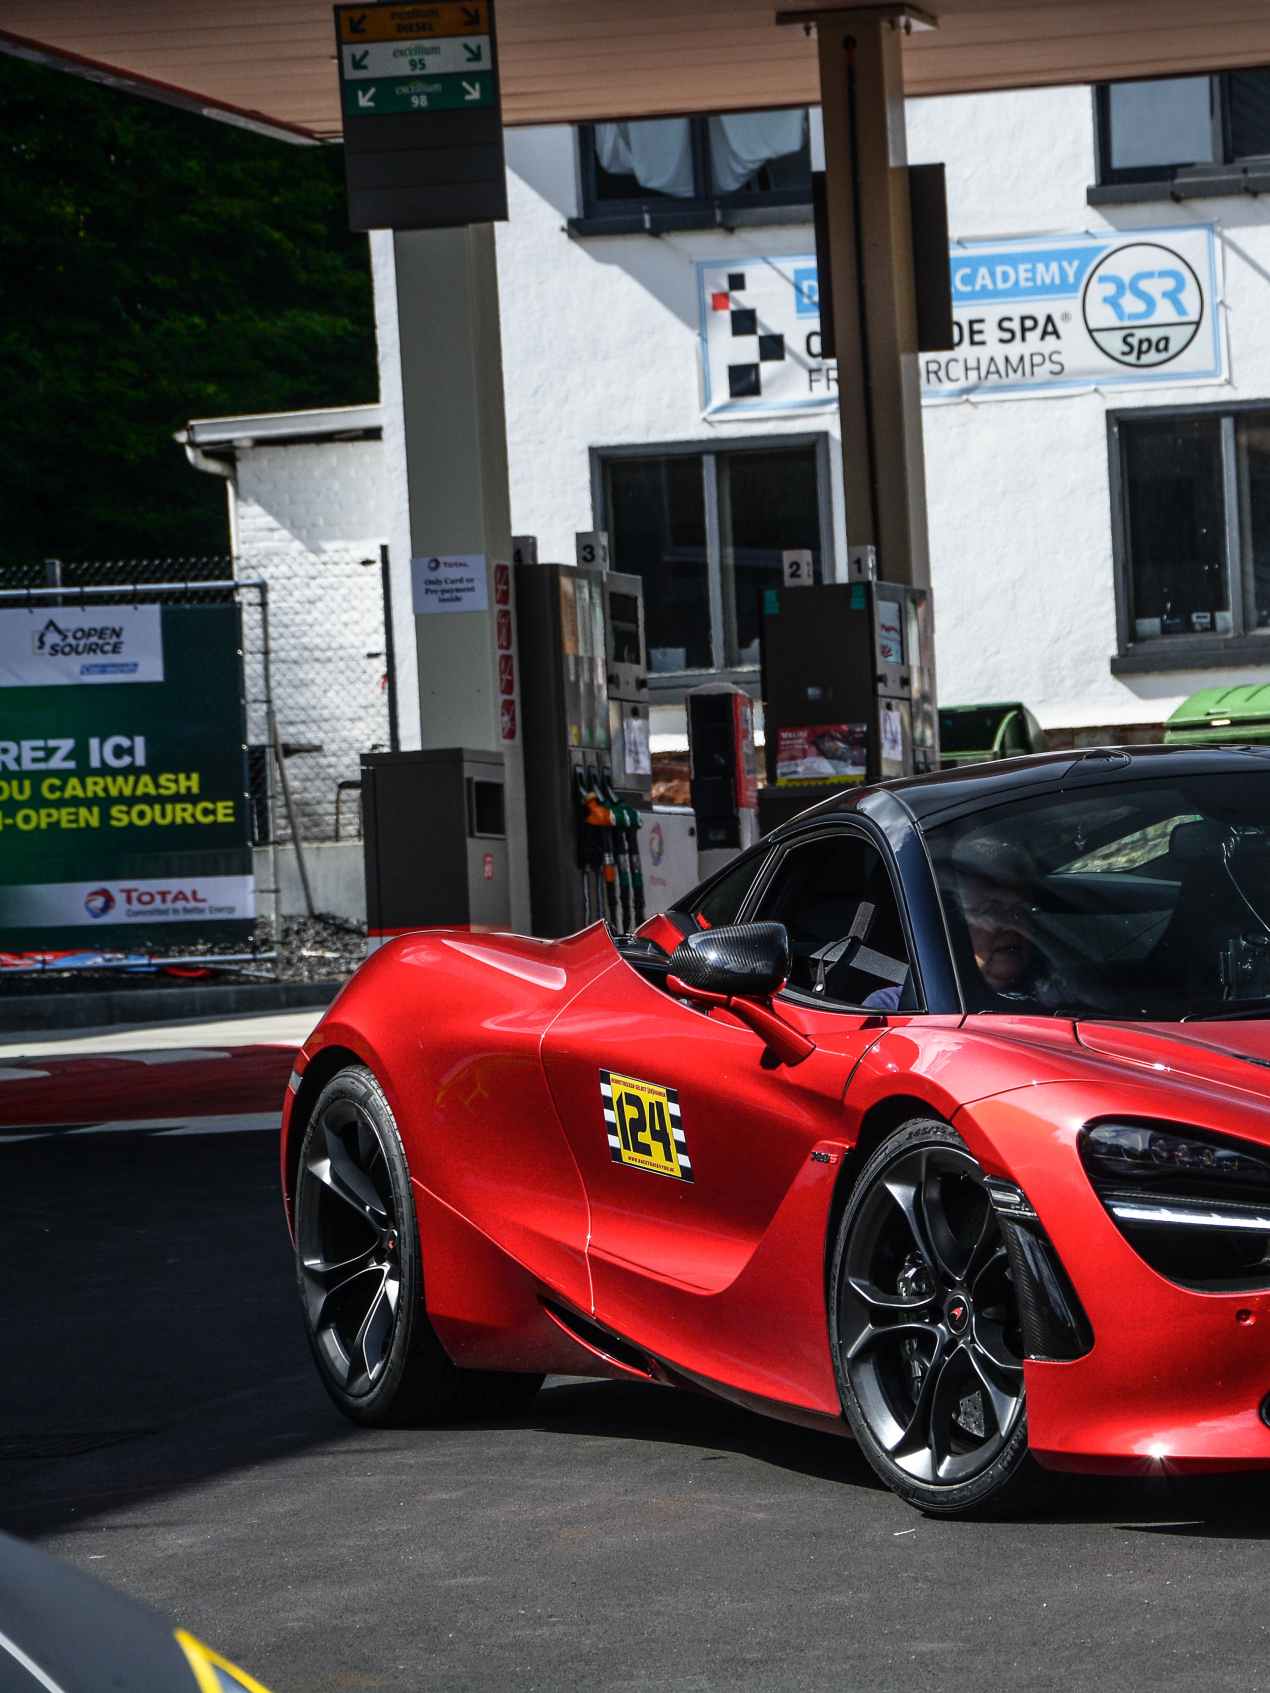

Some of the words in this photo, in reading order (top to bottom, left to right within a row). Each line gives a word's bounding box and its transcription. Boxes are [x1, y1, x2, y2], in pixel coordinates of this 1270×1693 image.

[396, 22, 435, 33] DIESEL
[409, 58, 427, 71] 95
[411, 95, 428, 108] 98
[953, 260, 1080, 293] CADEMY
[1097, 269, 1189, 322] RSR
[1121, 332, 1170, 361] Spa
[582, 543, 596, 563] 3
[443, 561, 470, 569] TOTAL
[789, 560, 802, 579] 2
[853, 556, 863, 574] 1
[444, 577, 464, 585] Card
[72, 626, 124, 641] OPEN
[48, 641, 124, 656] SOURCE
[89, 735, 147, 768] ICI
[41, 772, 200, 800] CARWASH
[109, 801, 236, 828] SOURCE
[120, 888, 208, 906] TOTAL
[126, 909, 169, 918] Committed
[183, 906, 206, 915] Better
[209, 905, 236, 915] Energy
[616, 1091, 673, 1162] 124
